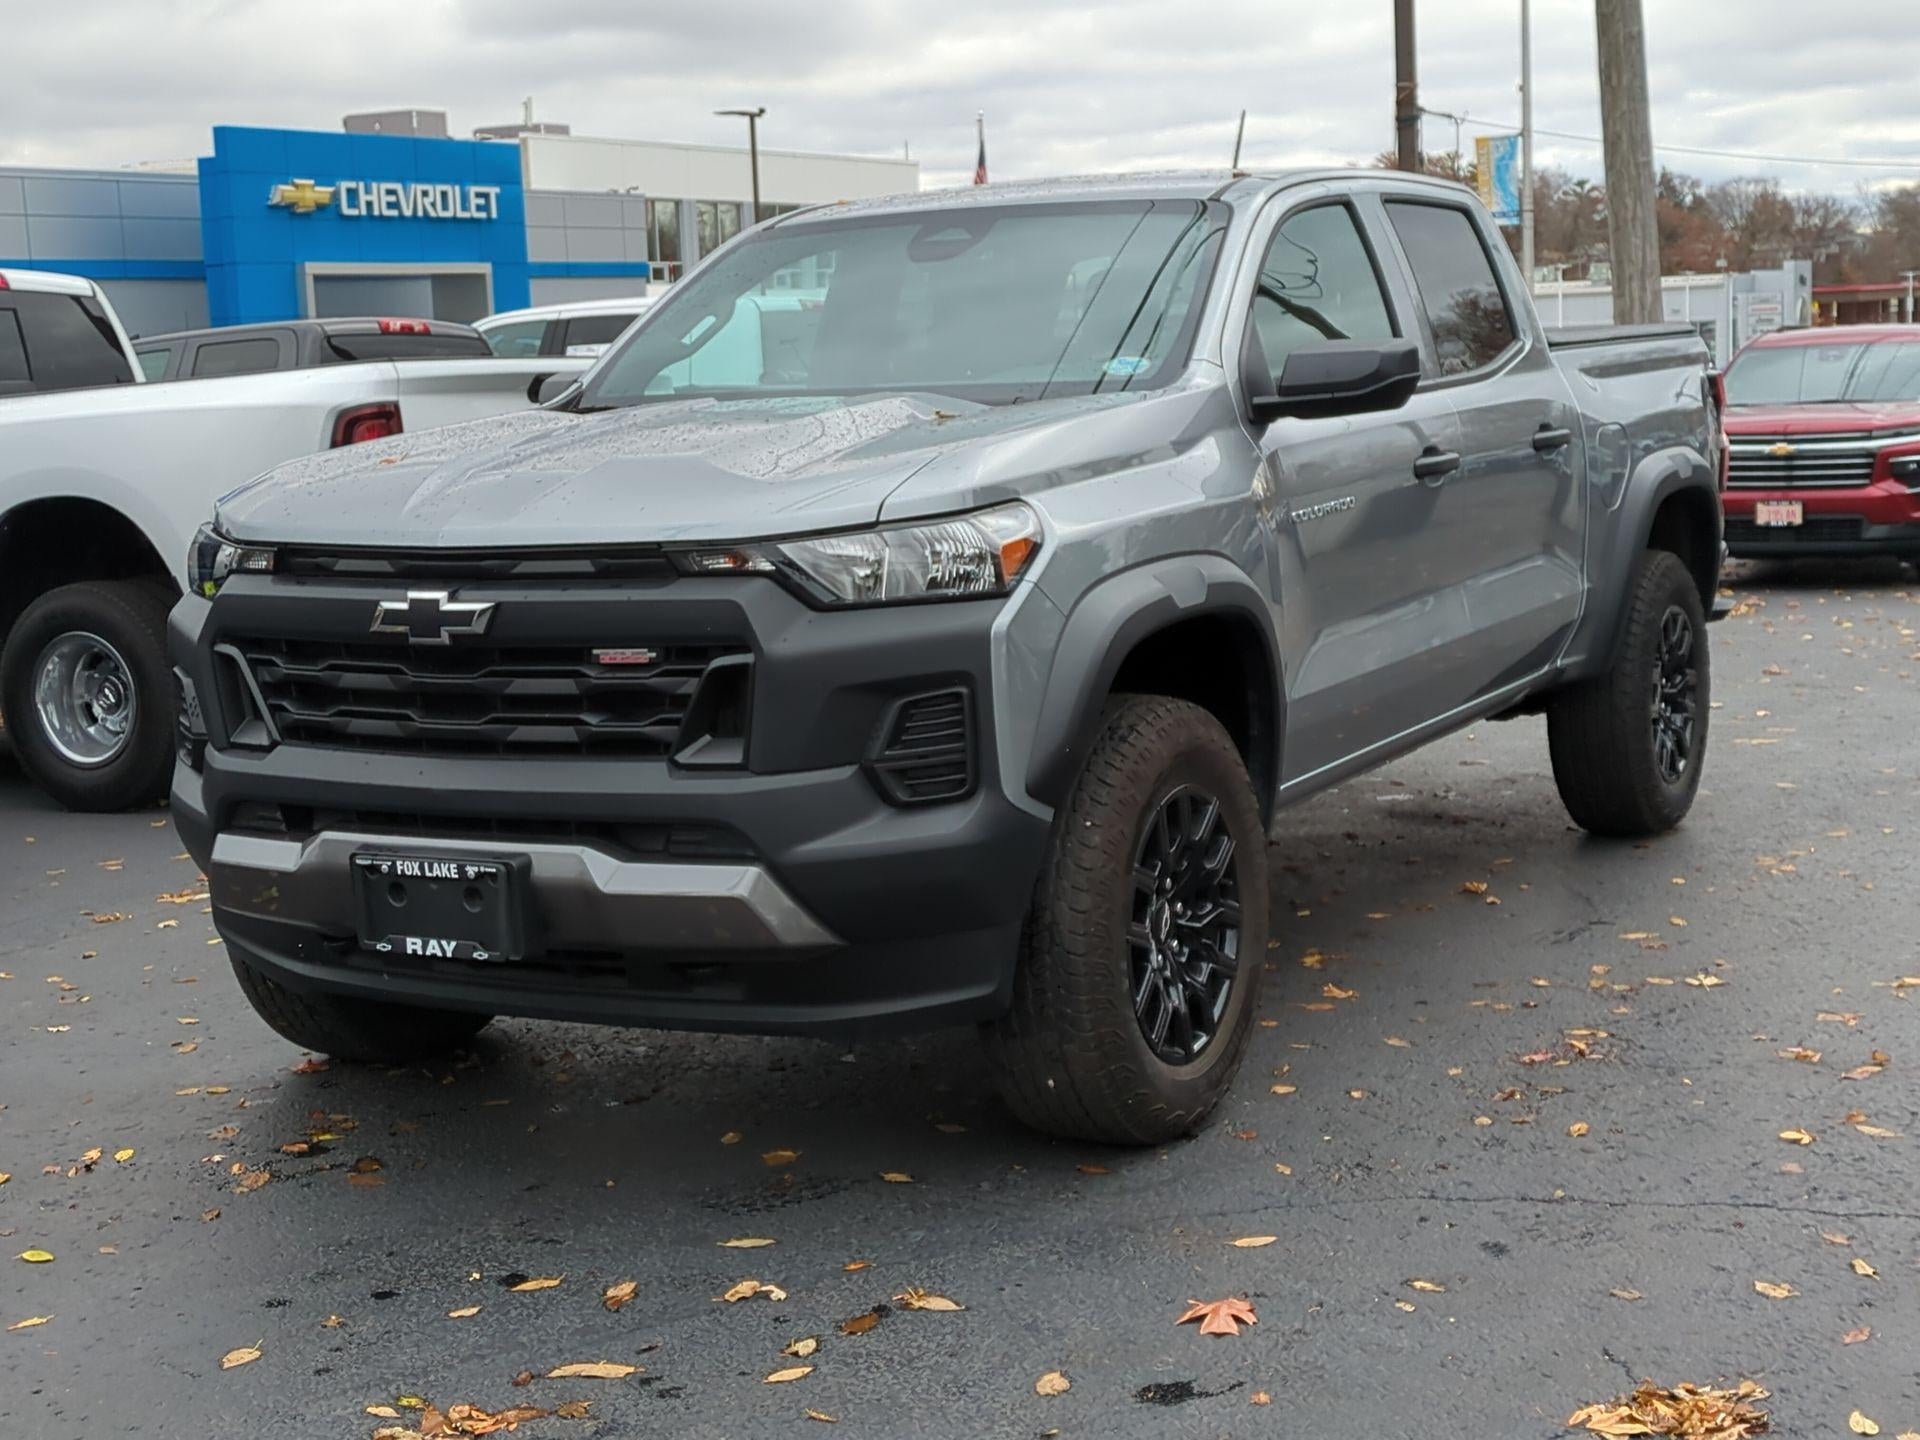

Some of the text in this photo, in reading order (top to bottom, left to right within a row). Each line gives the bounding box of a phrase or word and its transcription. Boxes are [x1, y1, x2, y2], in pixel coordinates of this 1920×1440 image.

[339, 180, 501, 219] CHEVROLET
[1291, 496, 1356, 521] COLORADO
[396, 860, 422, 876] FOX
[424, 861, 459, 879] LAKE
[405, 936, 458, 958] RAY
